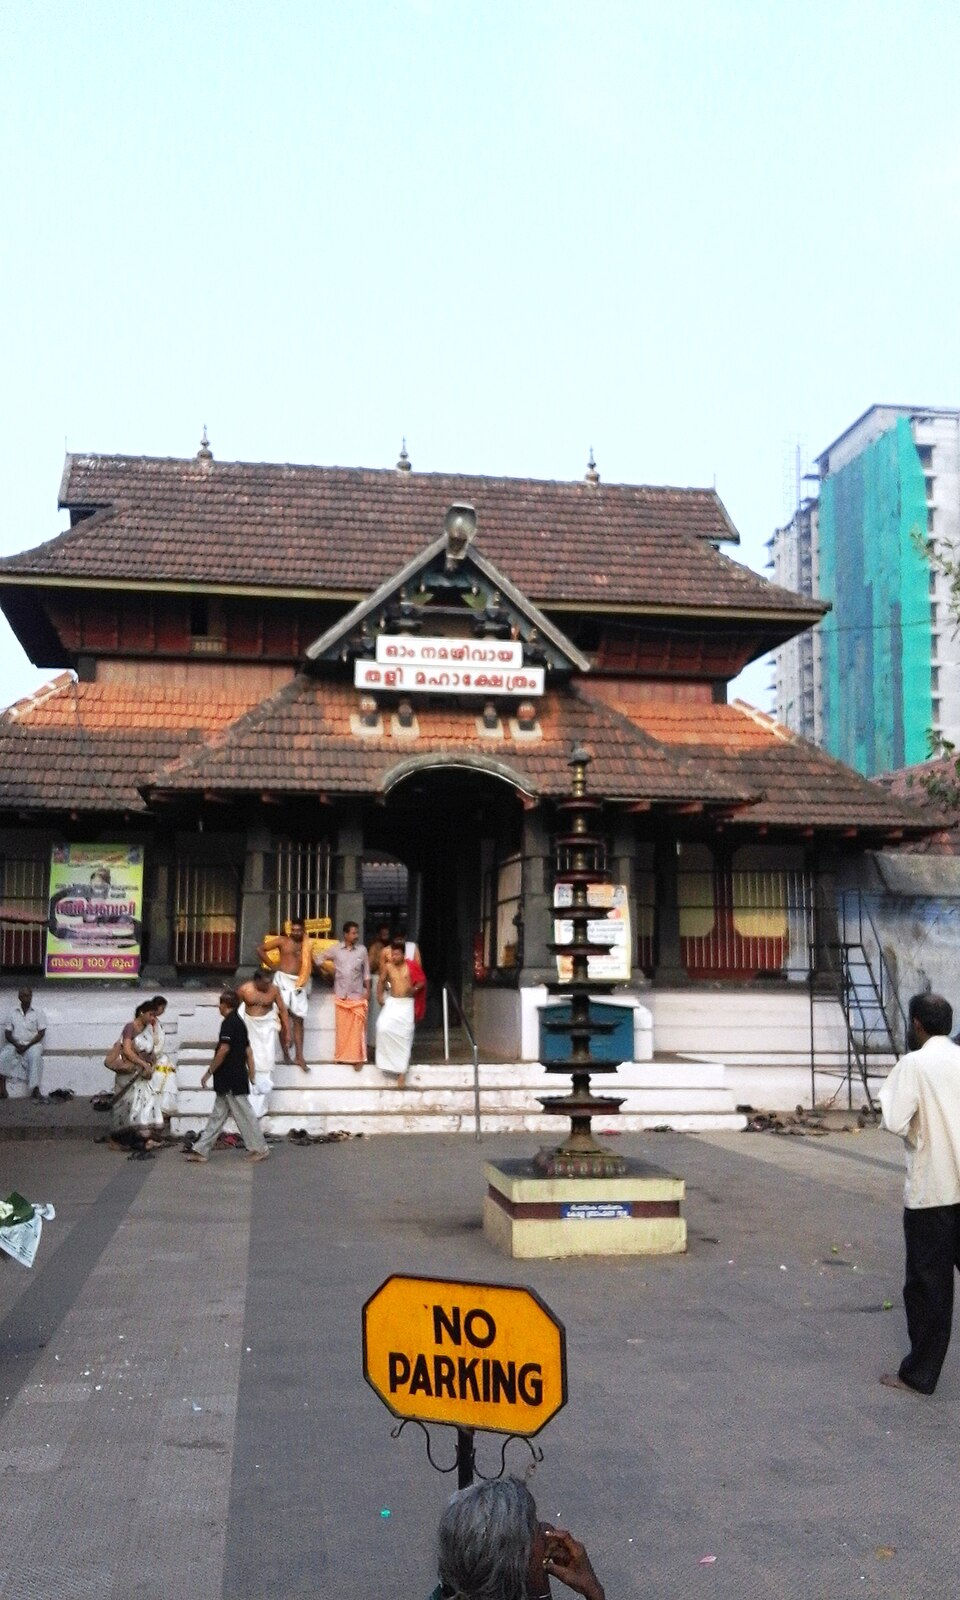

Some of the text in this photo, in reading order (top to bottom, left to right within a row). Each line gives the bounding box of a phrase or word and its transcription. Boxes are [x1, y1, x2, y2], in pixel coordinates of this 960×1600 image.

[385, 645, 415, 658] ഓം
[365, 667, 537, 691] തളി മഹാക്ഷേത്രം
[433, 1305, 497, 1348] NO
[389, 1352, 544, 1406] PARKING
